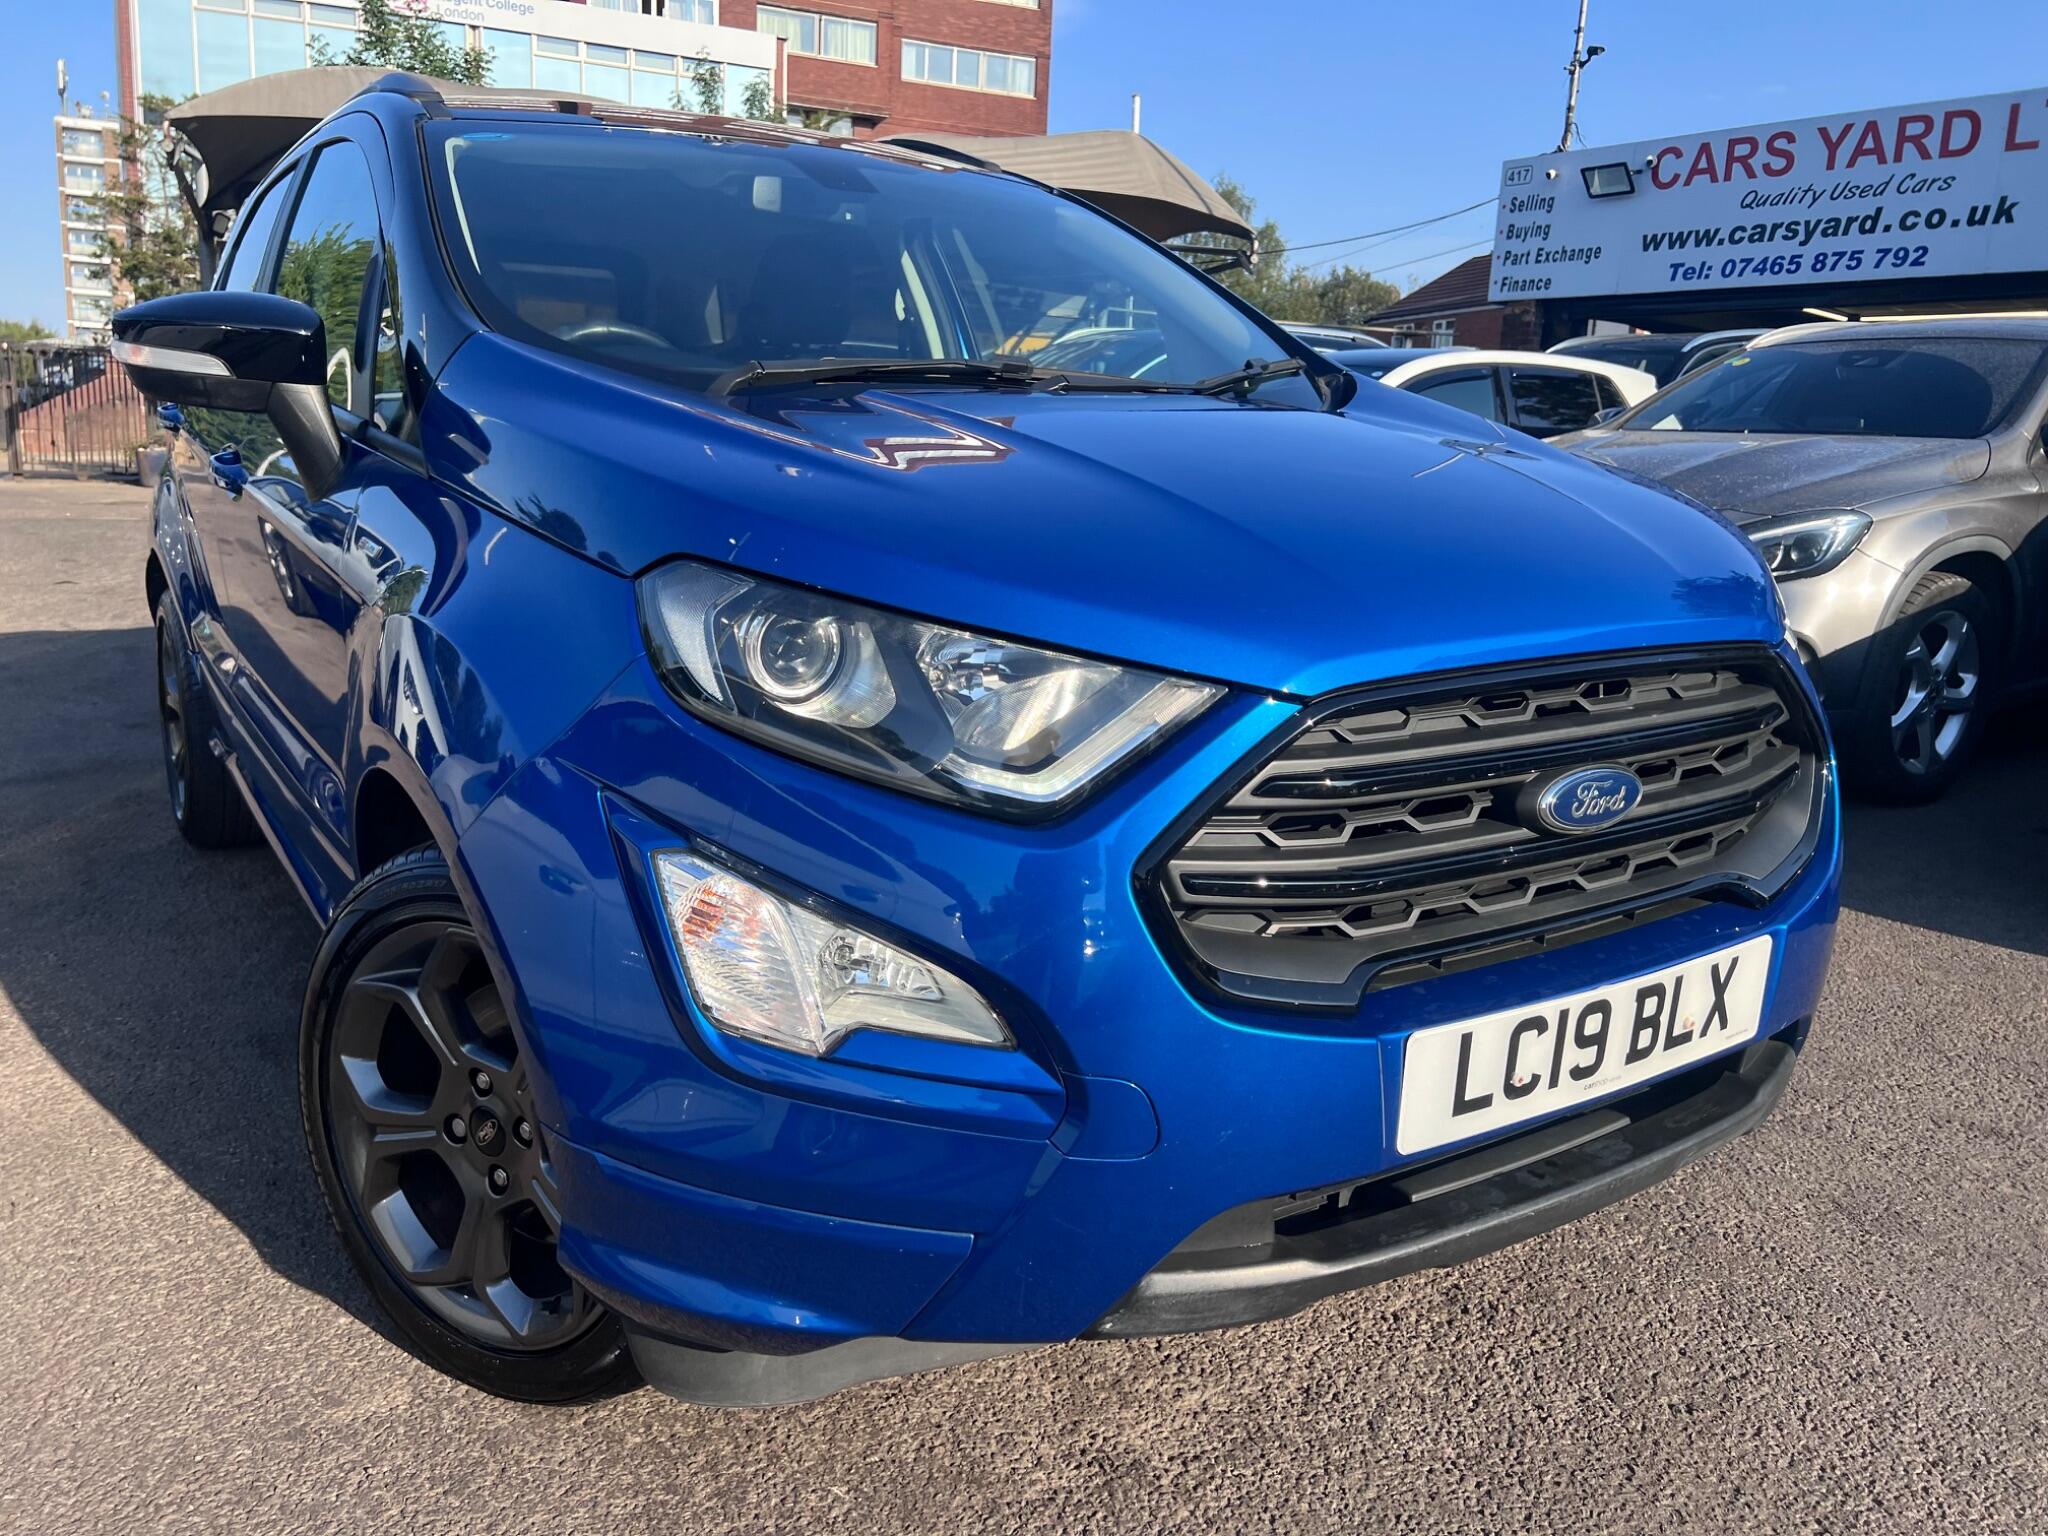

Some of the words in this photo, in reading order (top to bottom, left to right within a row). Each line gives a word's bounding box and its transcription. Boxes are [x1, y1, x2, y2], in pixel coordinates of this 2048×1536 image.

[437, 4, 485, 22] London
[486, 0, 535, 15] College
[1651, 129, 1795, 190] CARS
[1816, 109, 1982, 171] YARD
[2003, 98, 2048, 152] L
[1507, 168, 1531, 183] 417
[1740, 183, 1826, 210] Quality
[1830, 173, 1895, 202] Used
[1896, 172, 1957, 195] Cars
[1509, 193, 1556, 214] Selling
[1505, 221, 1552, 243] Buying
[1642, 195, 2020, 252] www.carsyard.co.uk
[1502, 248, 1531, 267] Part
[1534, 245, 1602, 265] Exchange
[1669, 260, 1714, 282] Tel:
[1720, 253, 1803, 279] 07465
[1810, 247, 1864, 273] 875
[1872, 245, 1929, 269] 792
[1499, 276, 1552, 294] Finance
[1571, 780, 1627, 819] Ford
[1452, 998, 1613, 1118] LC19
[1624, 955, 1740, 1067] BLX
